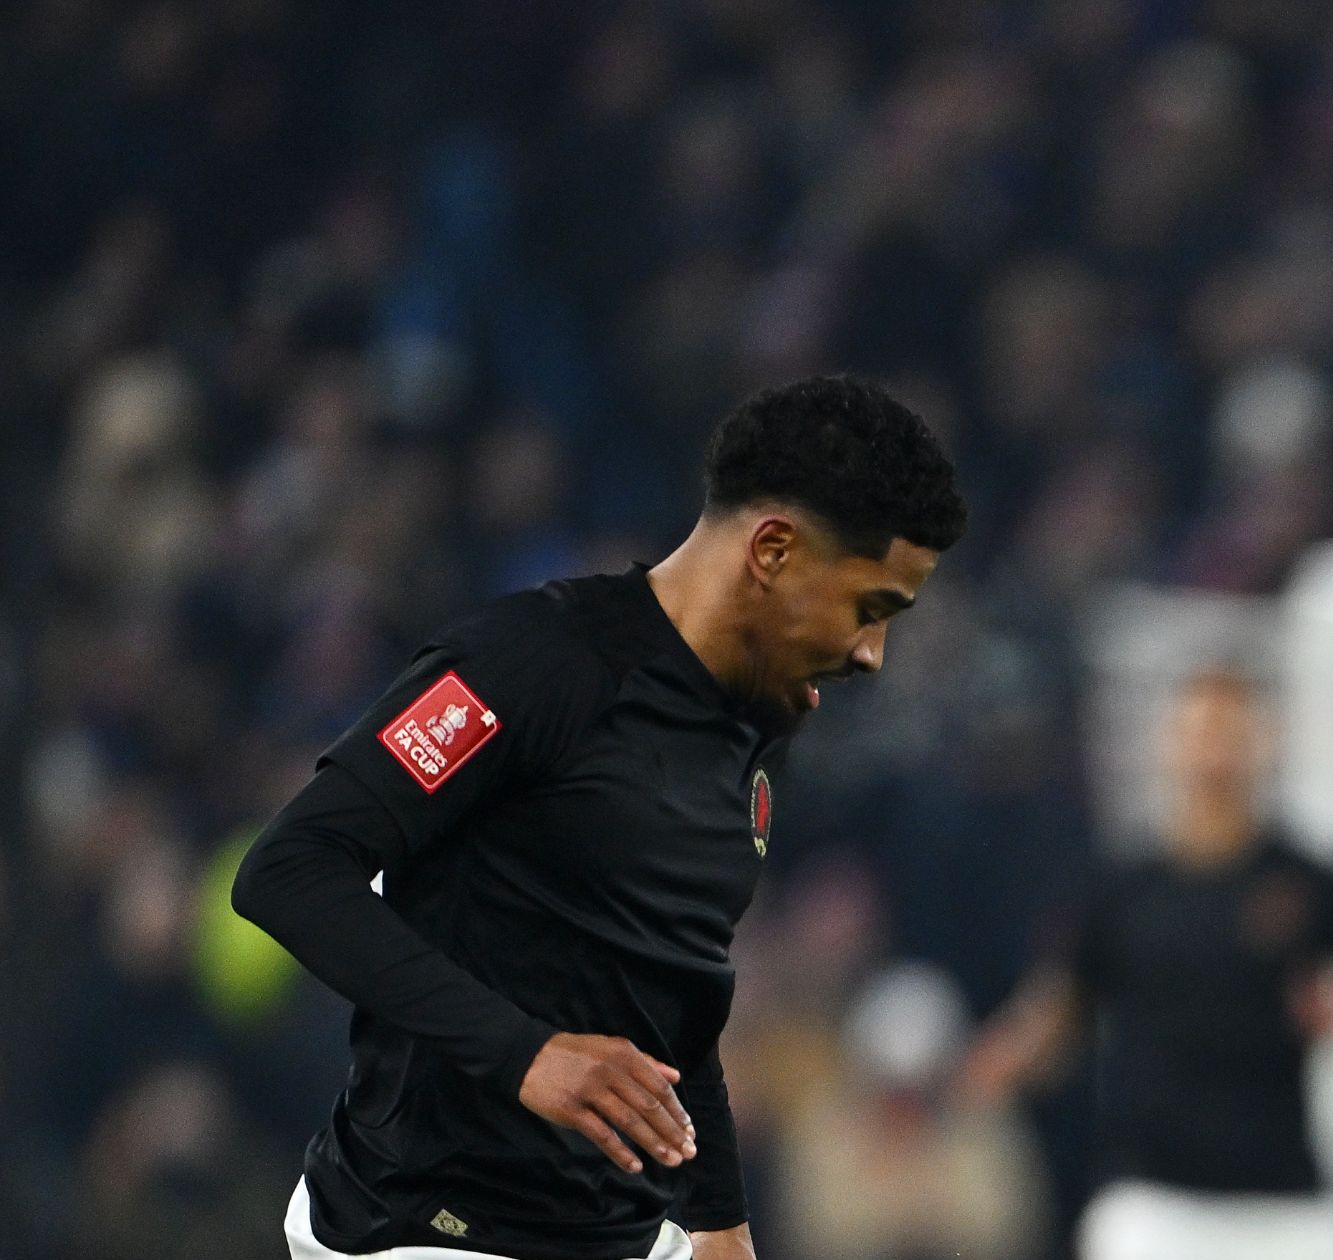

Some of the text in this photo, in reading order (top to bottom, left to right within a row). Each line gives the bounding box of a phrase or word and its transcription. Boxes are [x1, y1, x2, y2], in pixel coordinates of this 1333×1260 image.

[394, 728, 439, 775] FA CUP
[405, 719, 448, 768] Emirates
